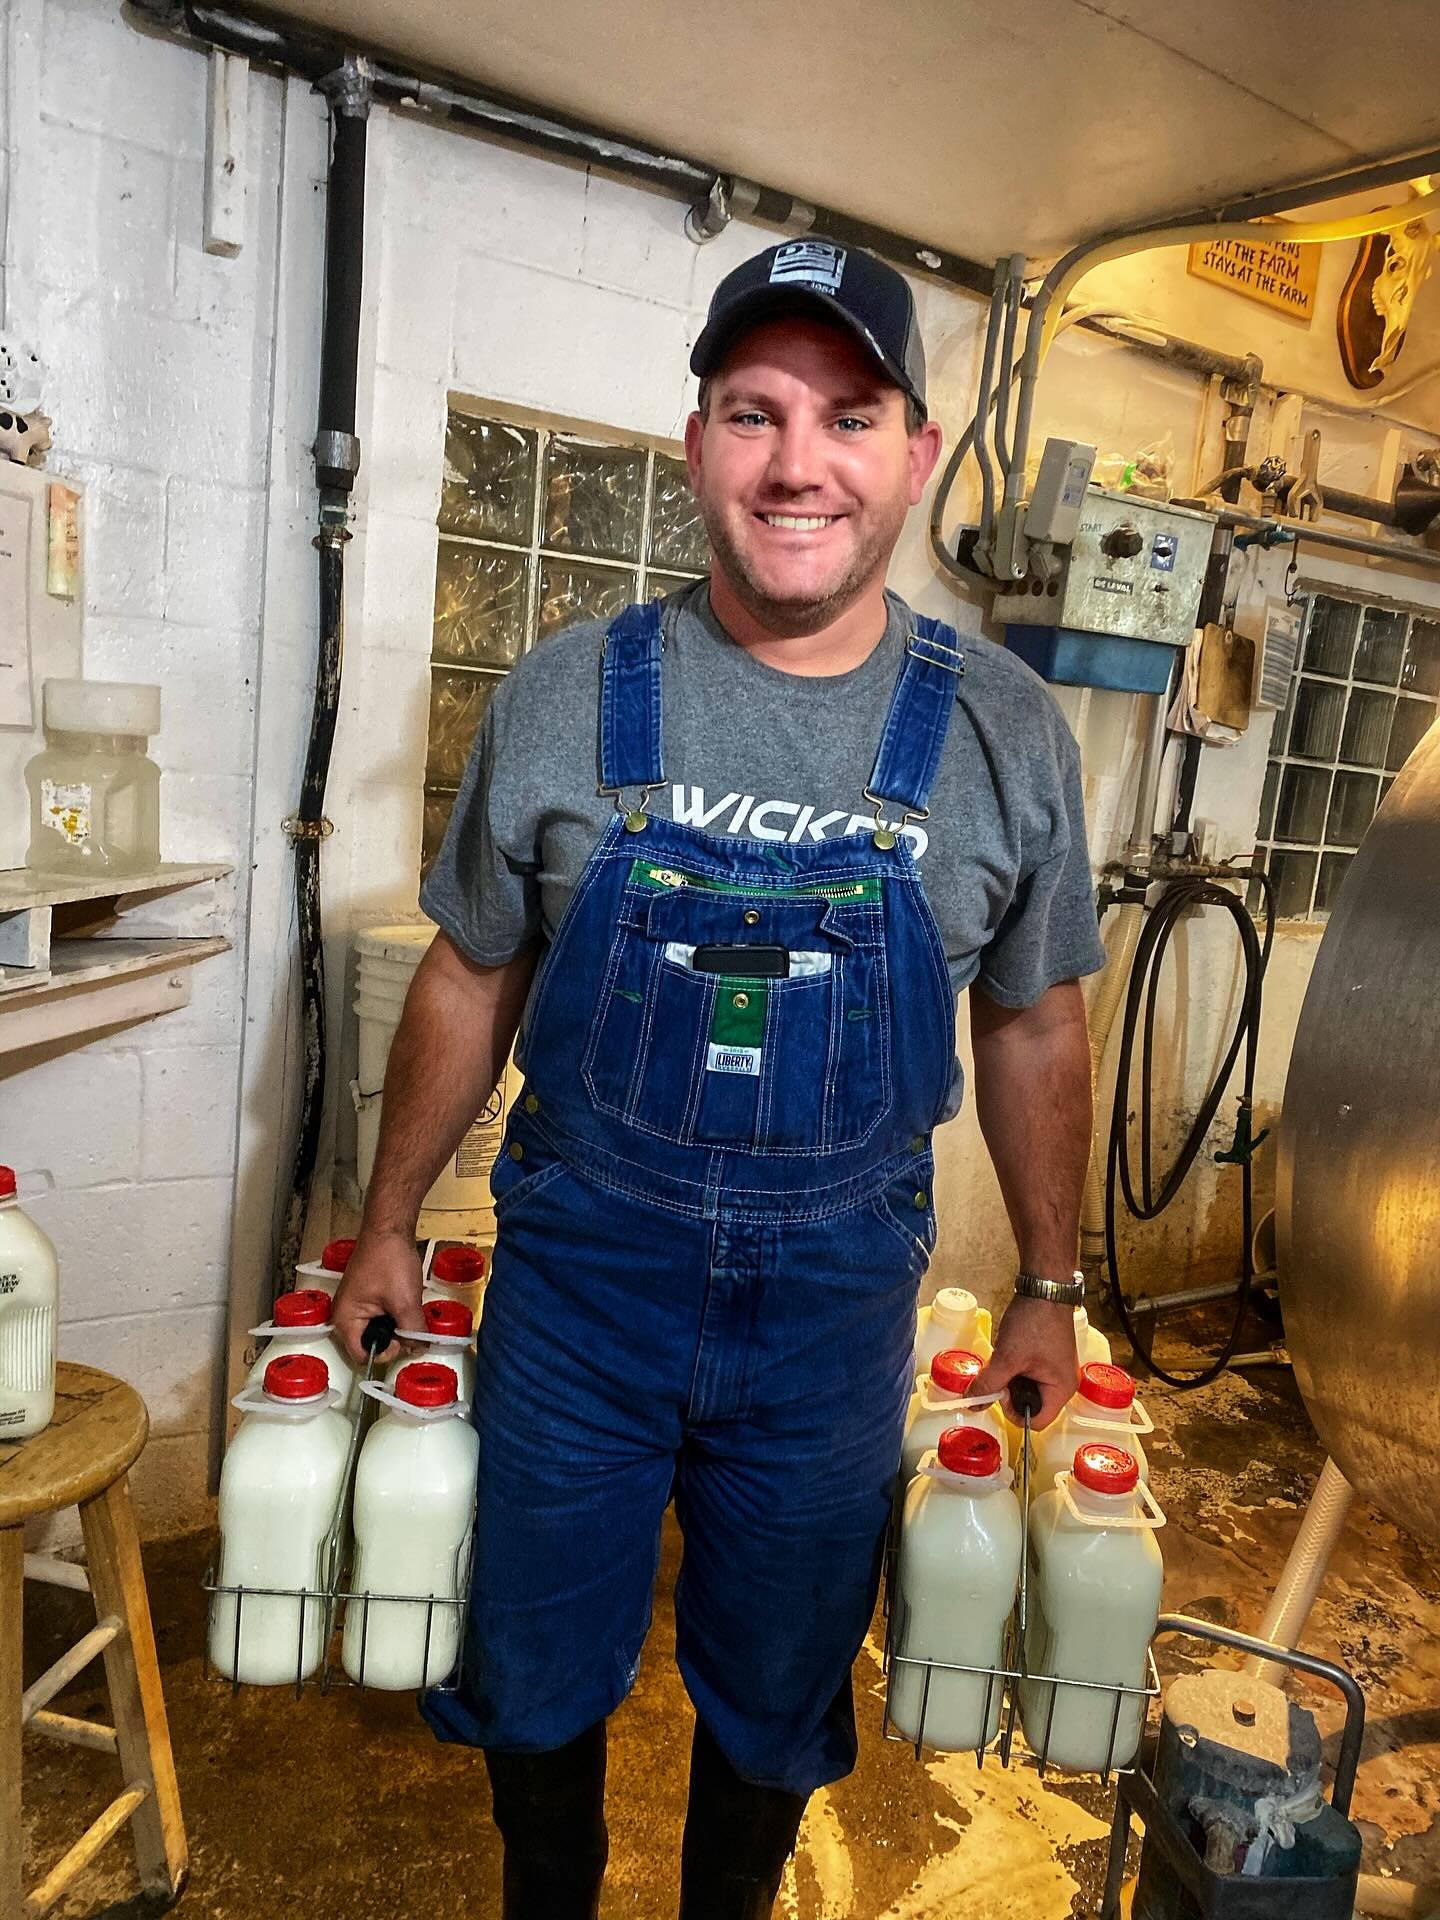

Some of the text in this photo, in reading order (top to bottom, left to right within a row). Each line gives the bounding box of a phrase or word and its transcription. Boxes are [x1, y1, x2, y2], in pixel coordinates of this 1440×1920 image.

[1234, 242, 1256, 265] THE
[1259, 249, 1300, 285] FARM
[1203, 251, 1308, 308] STAYS AT THE FARM
[1080, 523, 1102, 532] START
[718, 1055, 751, 1068] LIBERTY
